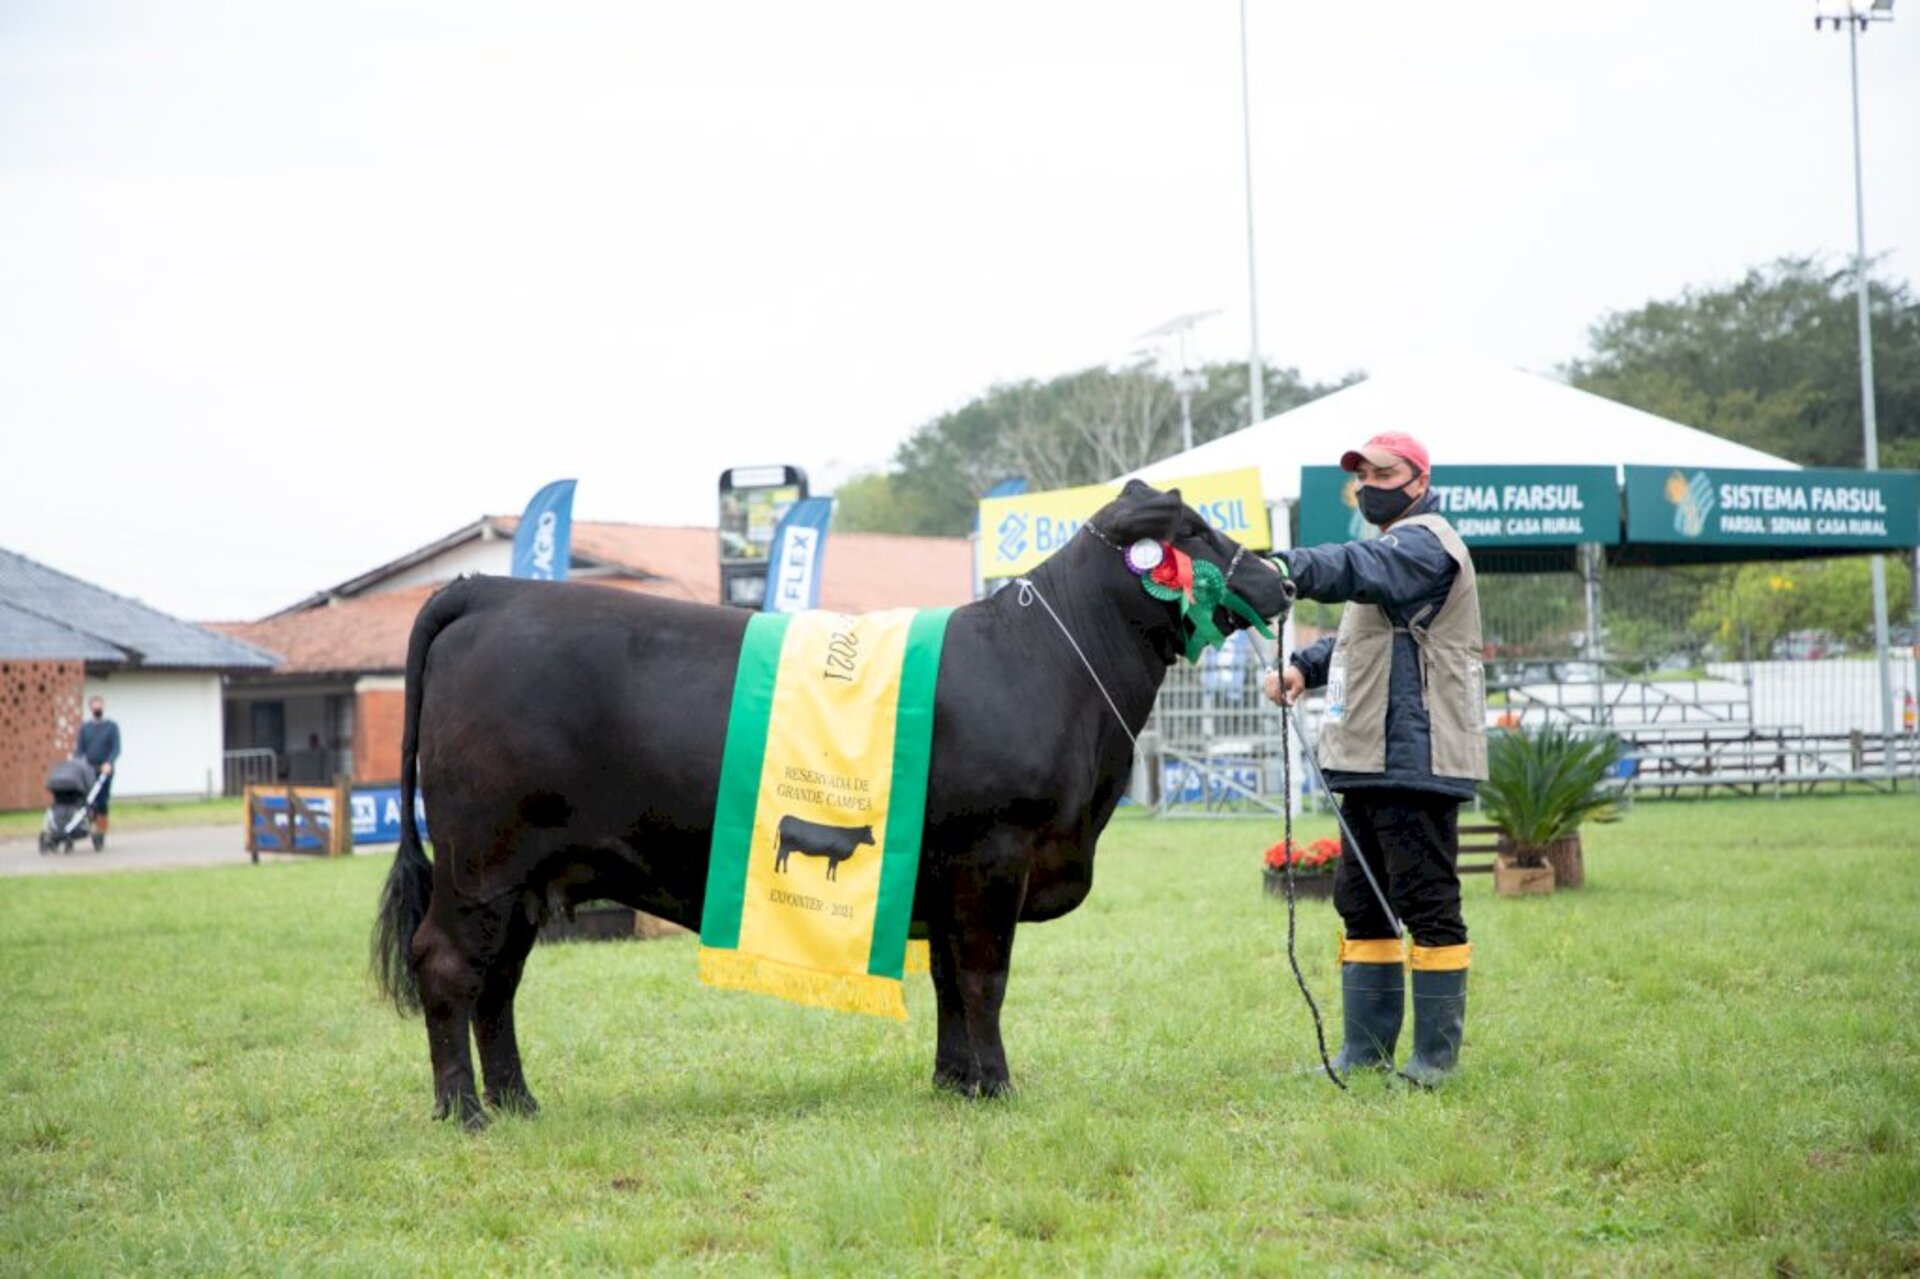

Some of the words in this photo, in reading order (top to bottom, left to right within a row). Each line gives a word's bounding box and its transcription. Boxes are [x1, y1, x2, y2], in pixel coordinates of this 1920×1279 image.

[1432, 484, 1499, 511] TEMA
[1503, 484, 1584, 511] FARSUL
[1720, 484, 1808, 511] SISTEMA
[1811, 486, 1886, 513] FARSUL
[1506, 518, 1540, 535] CASA
[1541, 517, 1583, 534] RURAL
[1770, 516, 1811, 535] SENAR
[1816, 517, 1848, 535] CASA
[1849, 518, 1887, 537] RURAL
[784, 534, 809, 600] FLEX
[776, 783, 824, 805] GRANDE
[854, 777, 870, 793] DE
